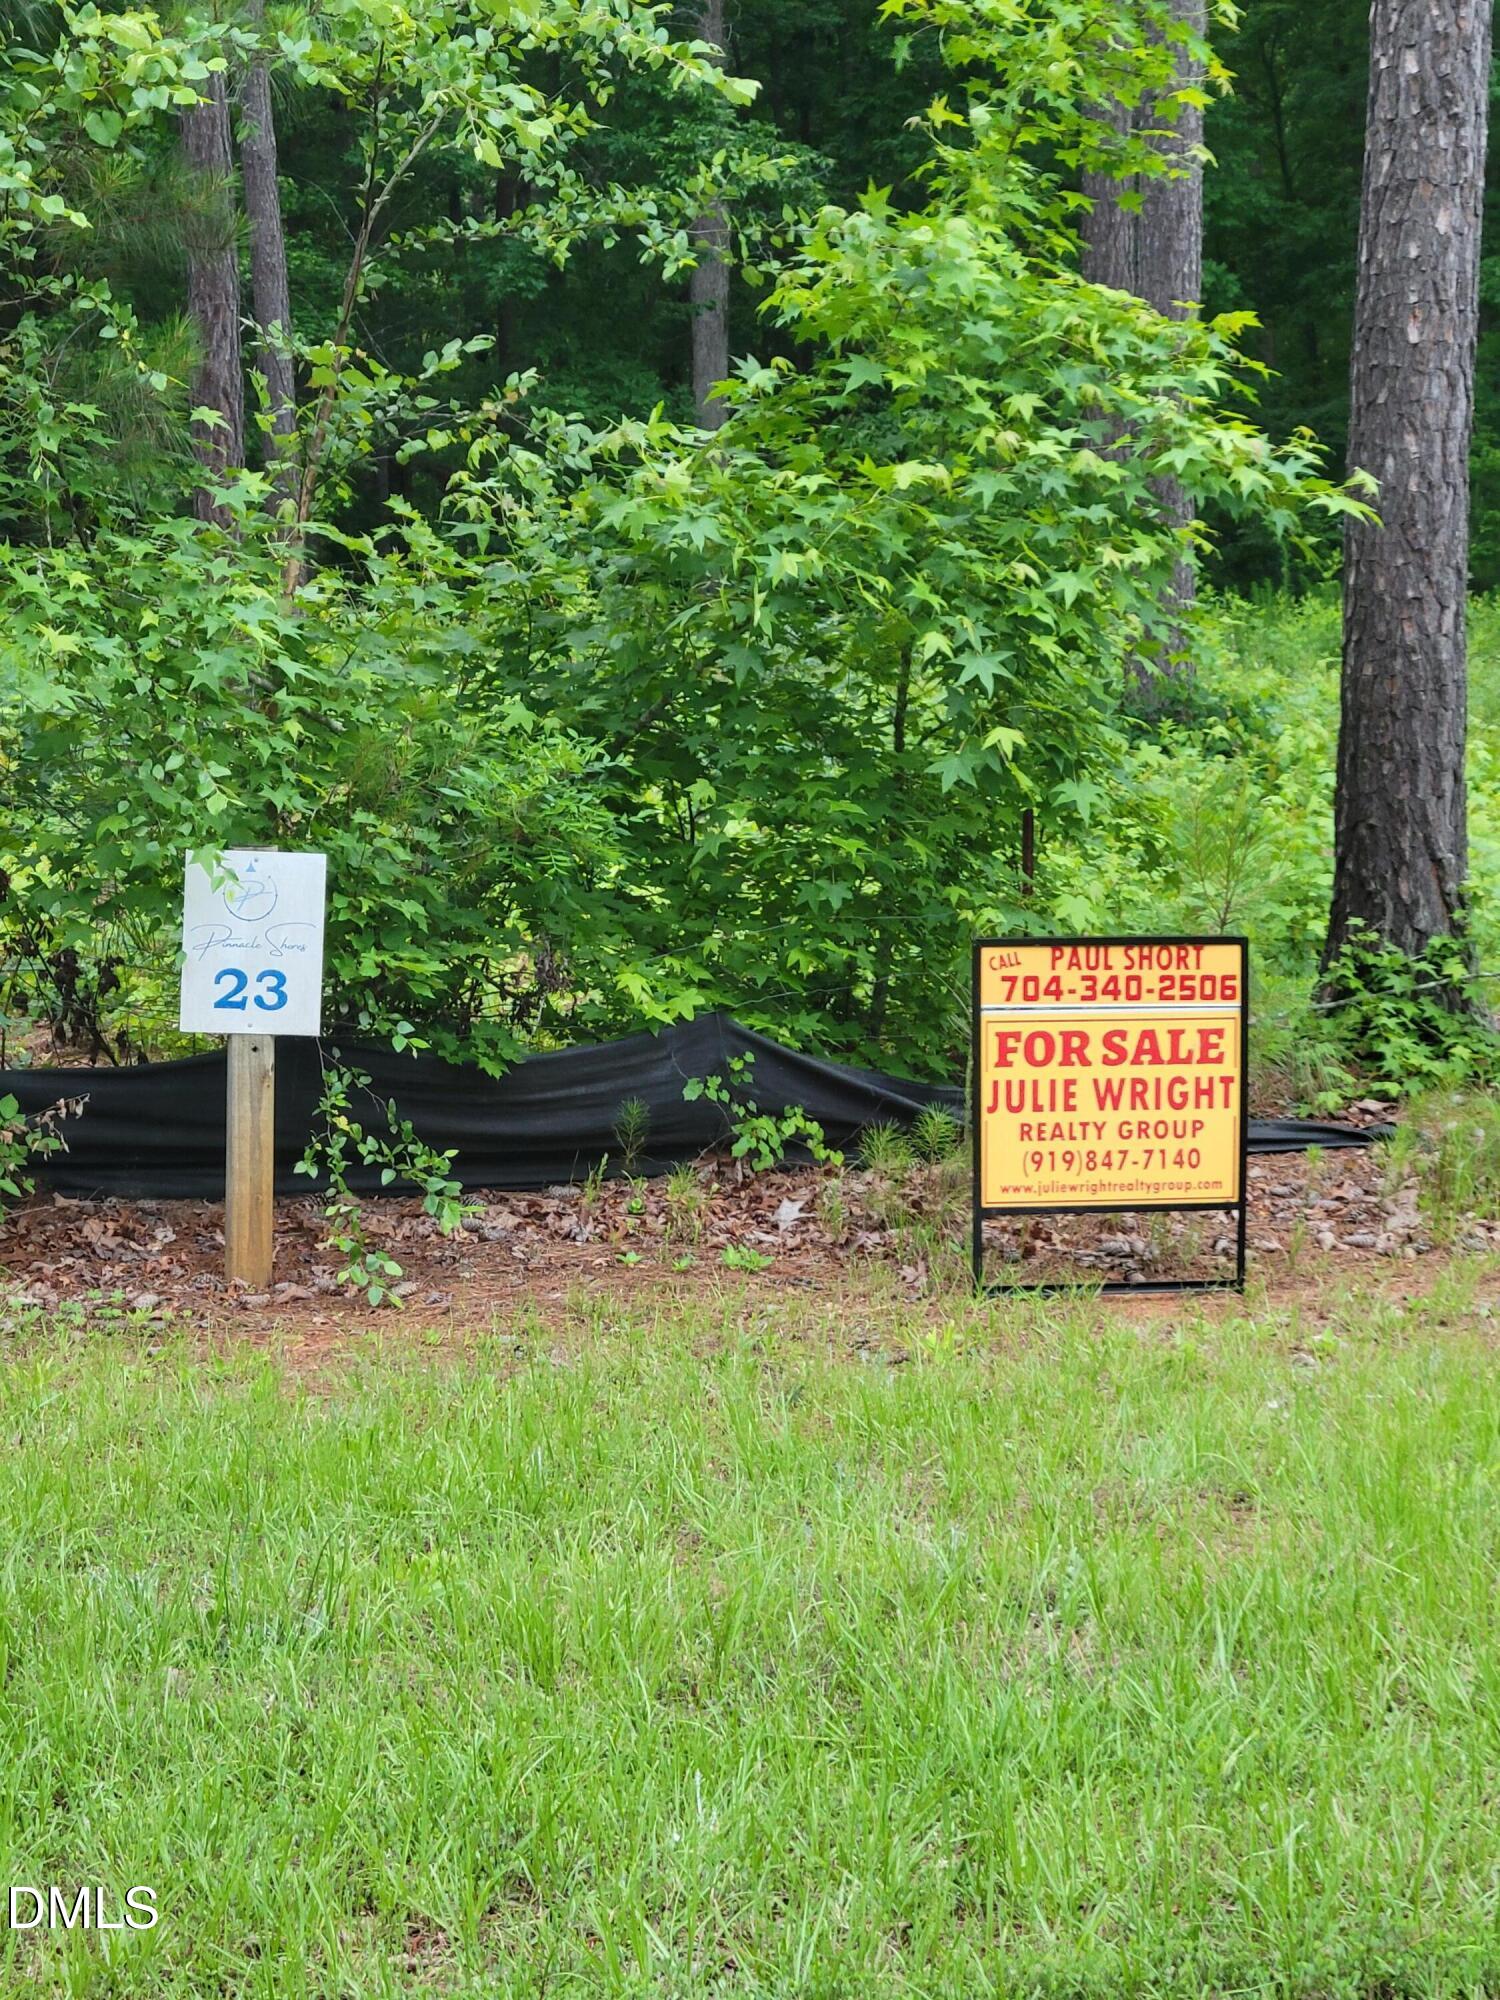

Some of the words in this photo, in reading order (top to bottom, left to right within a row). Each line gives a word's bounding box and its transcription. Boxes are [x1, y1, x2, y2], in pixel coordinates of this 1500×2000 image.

[191, 923, 263, 961] Pinnacle
[265, 922, 317, 957] Shores
[989, 952, 1022, 971] CALL
[1051, 946, 1113, 971] PAUL
[1123, 945, 1204, 971] SHORT
[213, 968, 288, 1011] 23
[1001, 974, 1237, 1002] 704-340-2506
[994, 1030, 1092, 1068] FOR
[1101, 1028, 1225, 1066] SALE
[986, 1078, 1077, 1114] JULIE
[1093, 1076, 1235, 1112] WRIGHT
[1019, 1121, 1107, 1142] REALTY
[1118, 1120, 1205, 1140] GROUP
[1023, 1148, 1201, 1177] (919)847-7140
[1000, 1178, 1223, 1196] www.juliewrightrealtygroup.com
